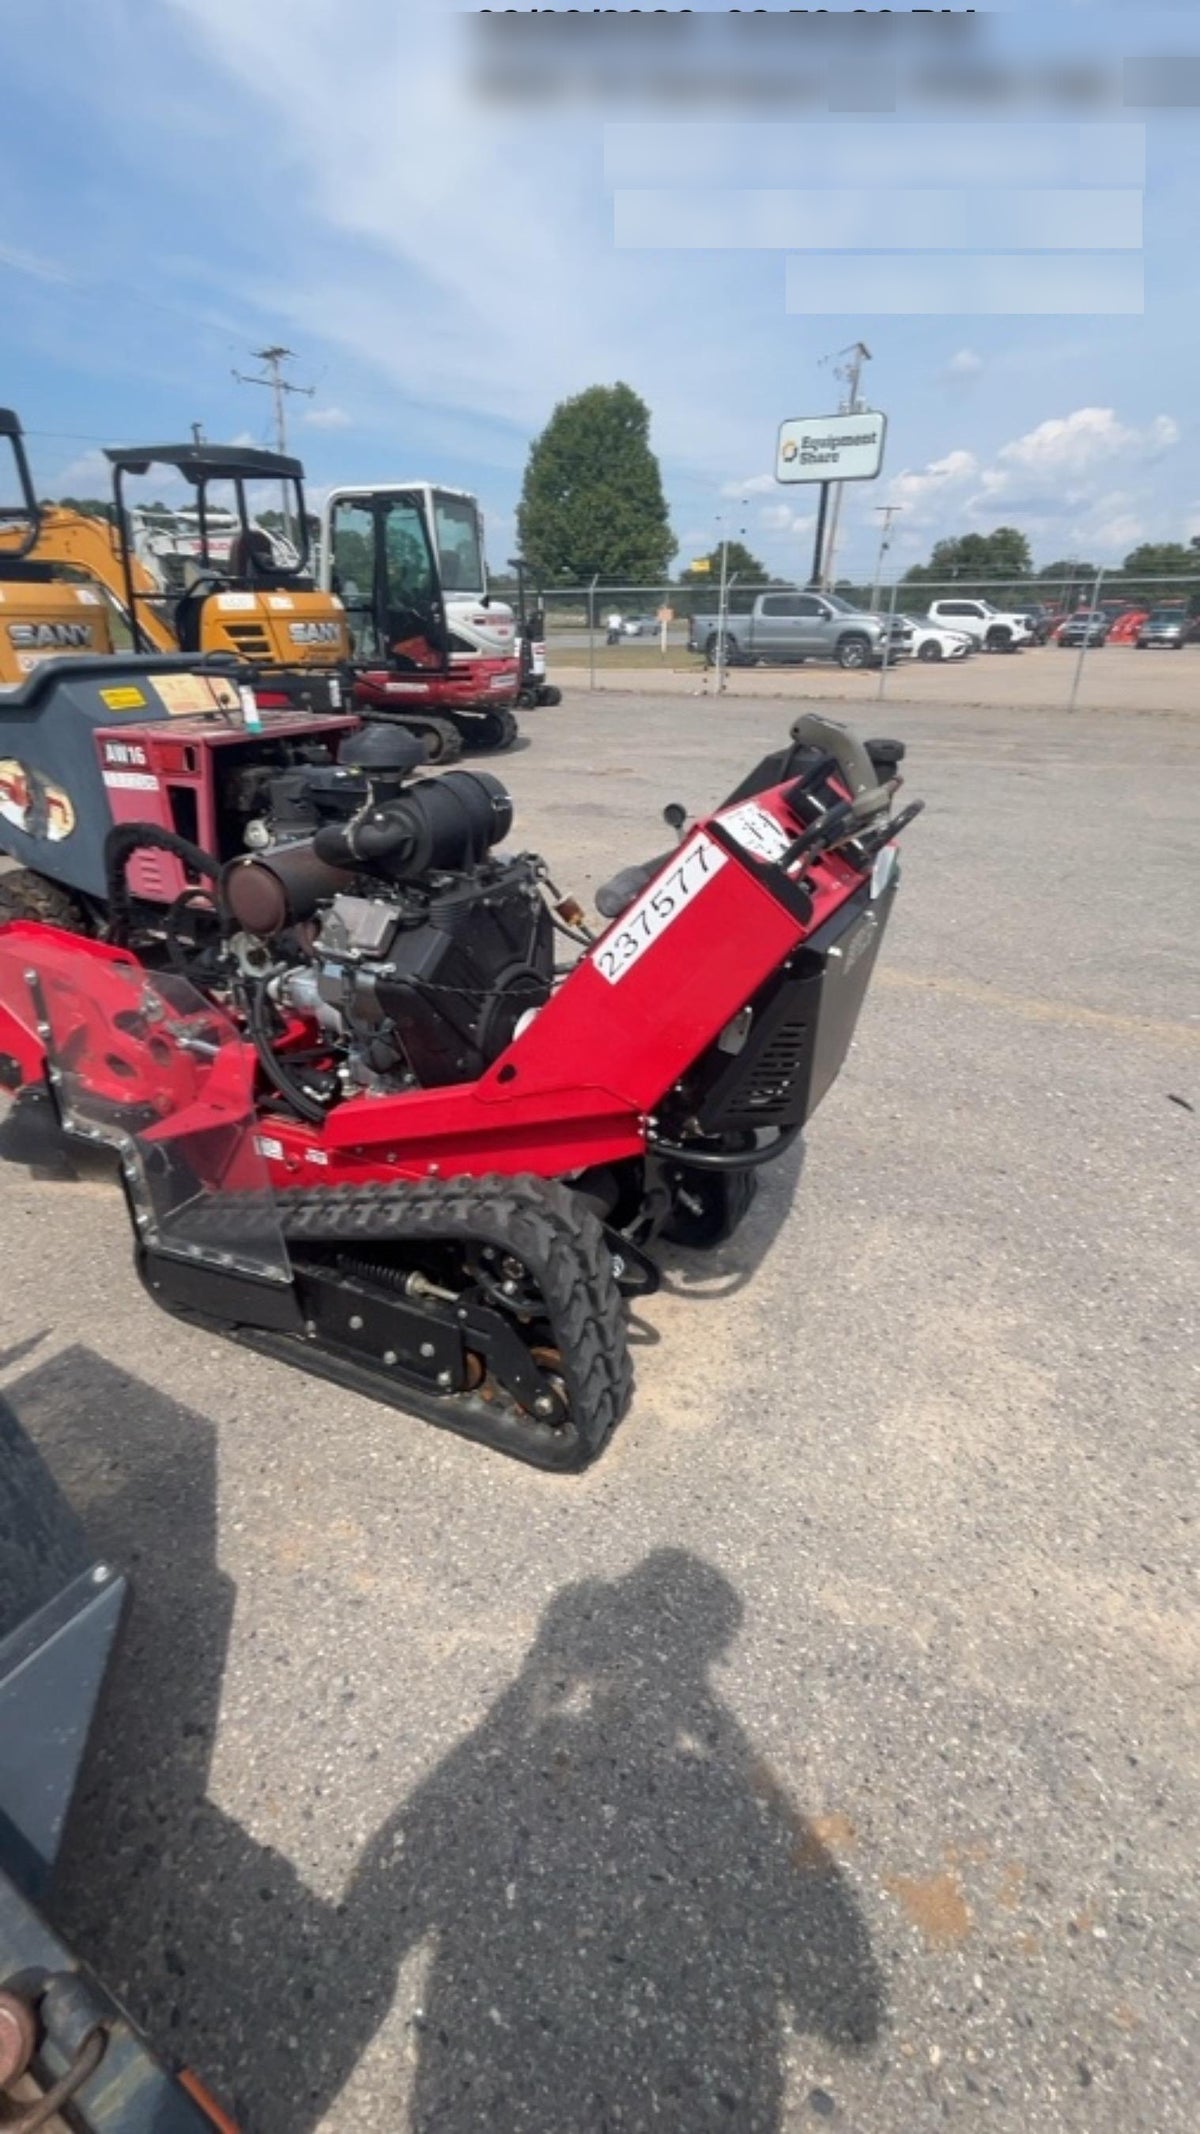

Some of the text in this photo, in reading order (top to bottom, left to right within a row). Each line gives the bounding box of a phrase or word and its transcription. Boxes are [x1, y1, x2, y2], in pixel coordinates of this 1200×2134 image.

[801, 432, 876, 451] Equipment
[800, 452, 839, 465] Share
[9, 624, 92, 648] SANY
[290, 622, 340, 644] SANY
[105, 743, 147, 765] AW16
[598, 845, 709, 977] 237577
